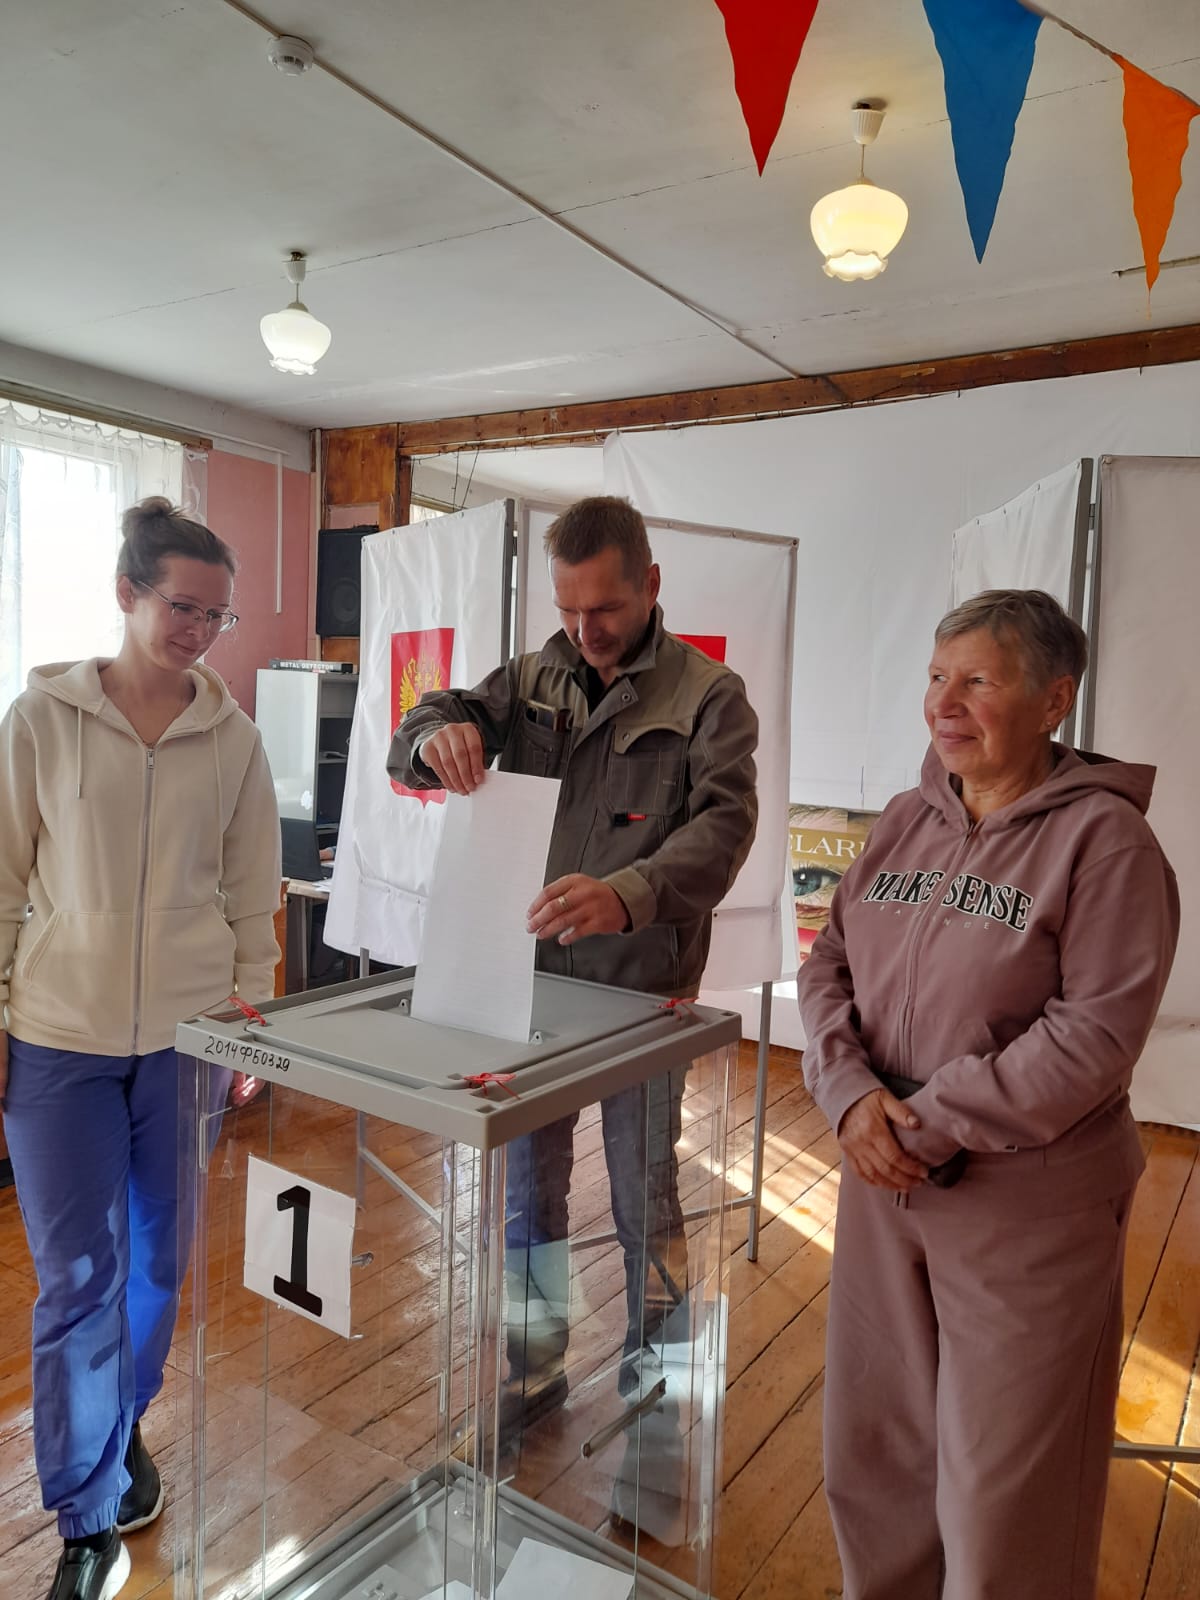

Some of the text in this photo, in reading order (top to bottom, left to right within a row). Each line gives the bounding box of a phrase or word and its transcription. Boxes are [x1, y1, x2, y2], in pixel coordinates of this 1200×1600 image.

[280, 661, 300, 669] METAL
[863, 870, 945, 905] MAKE
[941, 873, 1033, 932] SENSE
[273, 1185, 323, 1317] 1
